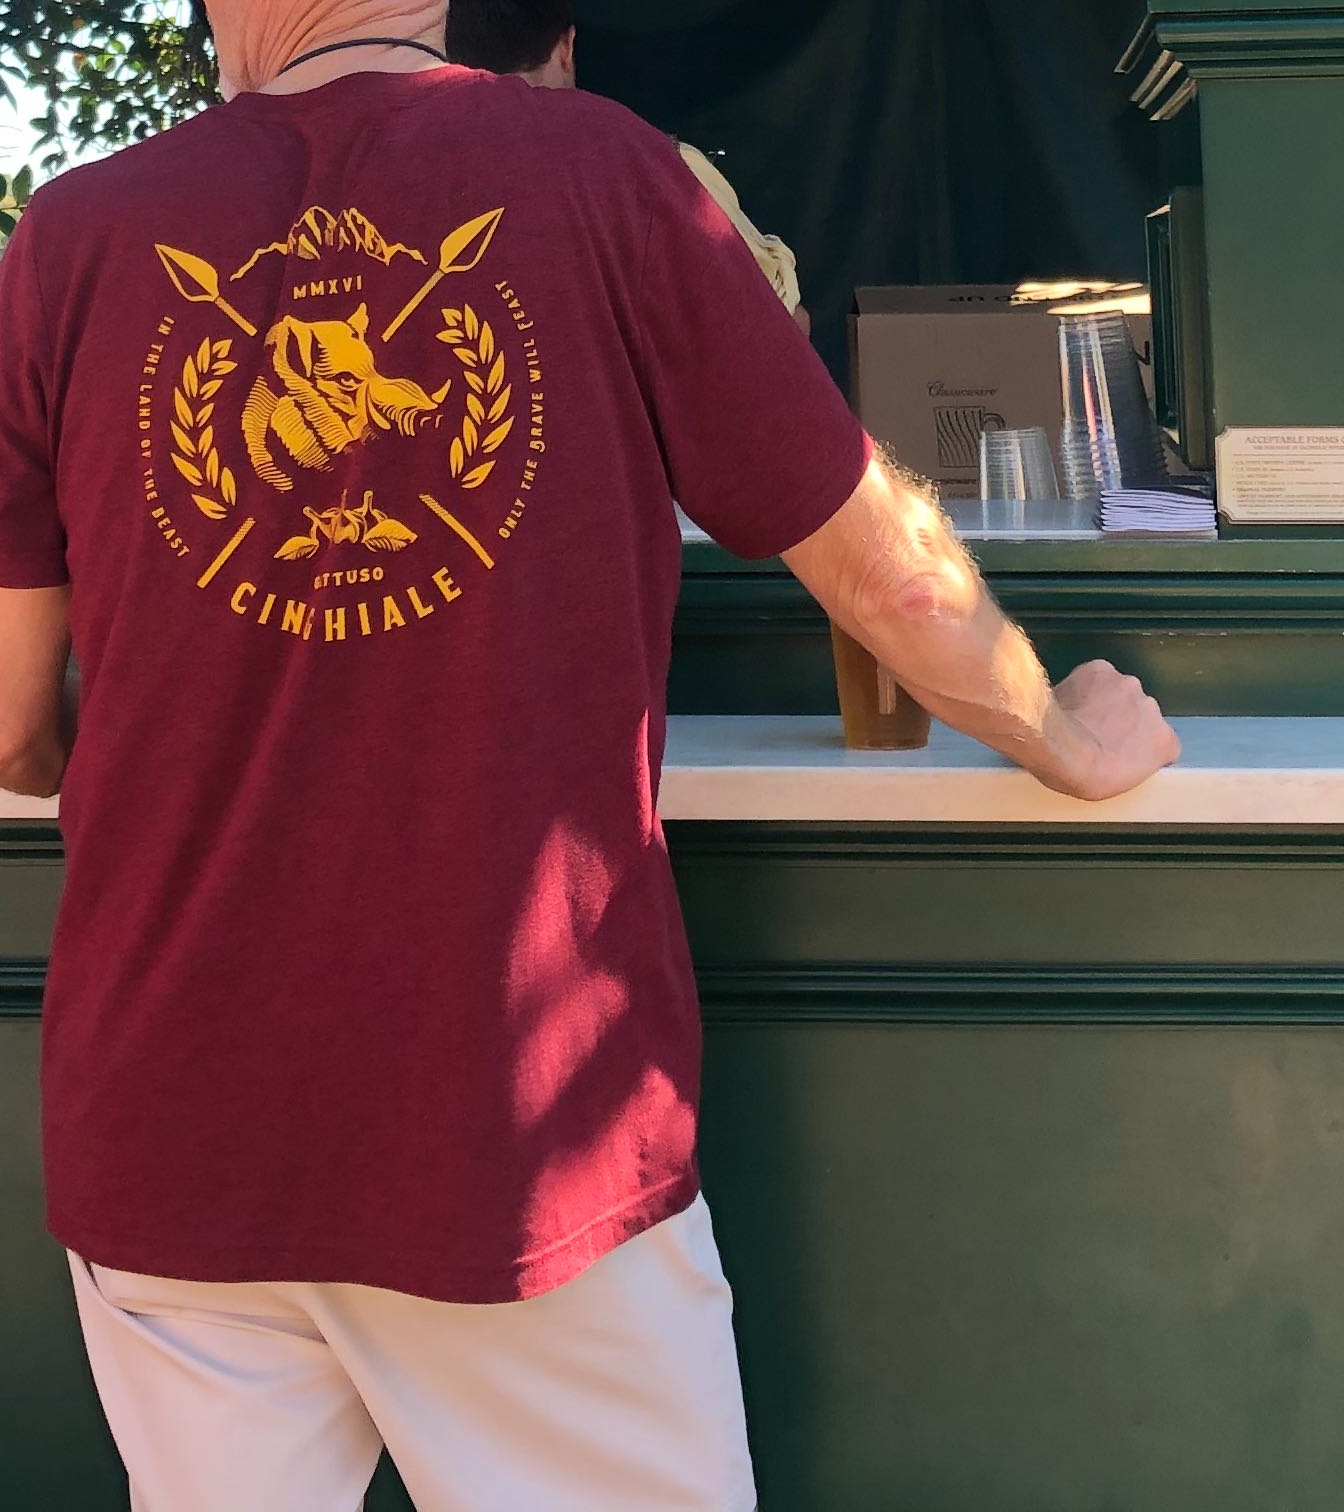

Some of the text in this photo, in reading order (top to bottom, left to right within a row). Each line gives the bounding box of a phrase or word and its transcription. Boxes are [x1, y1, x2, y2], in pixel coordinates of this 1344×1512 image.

[293, 275, 362, 300] MMXVI
[157, 316, 175, 335] IN
[143, 343, 164, 375] THE
[138, 384, 153, 431] LAND
[494, 280, 546, 539] ONLY THE BRAVE WILL FEAST
[1245, 435, 1305, 444] ACCEPTABLE
[1306, 435, 1339, 444] FORMS
[143, 468, 158, 501] THE
[151, 506, 190, 557] BEAST
